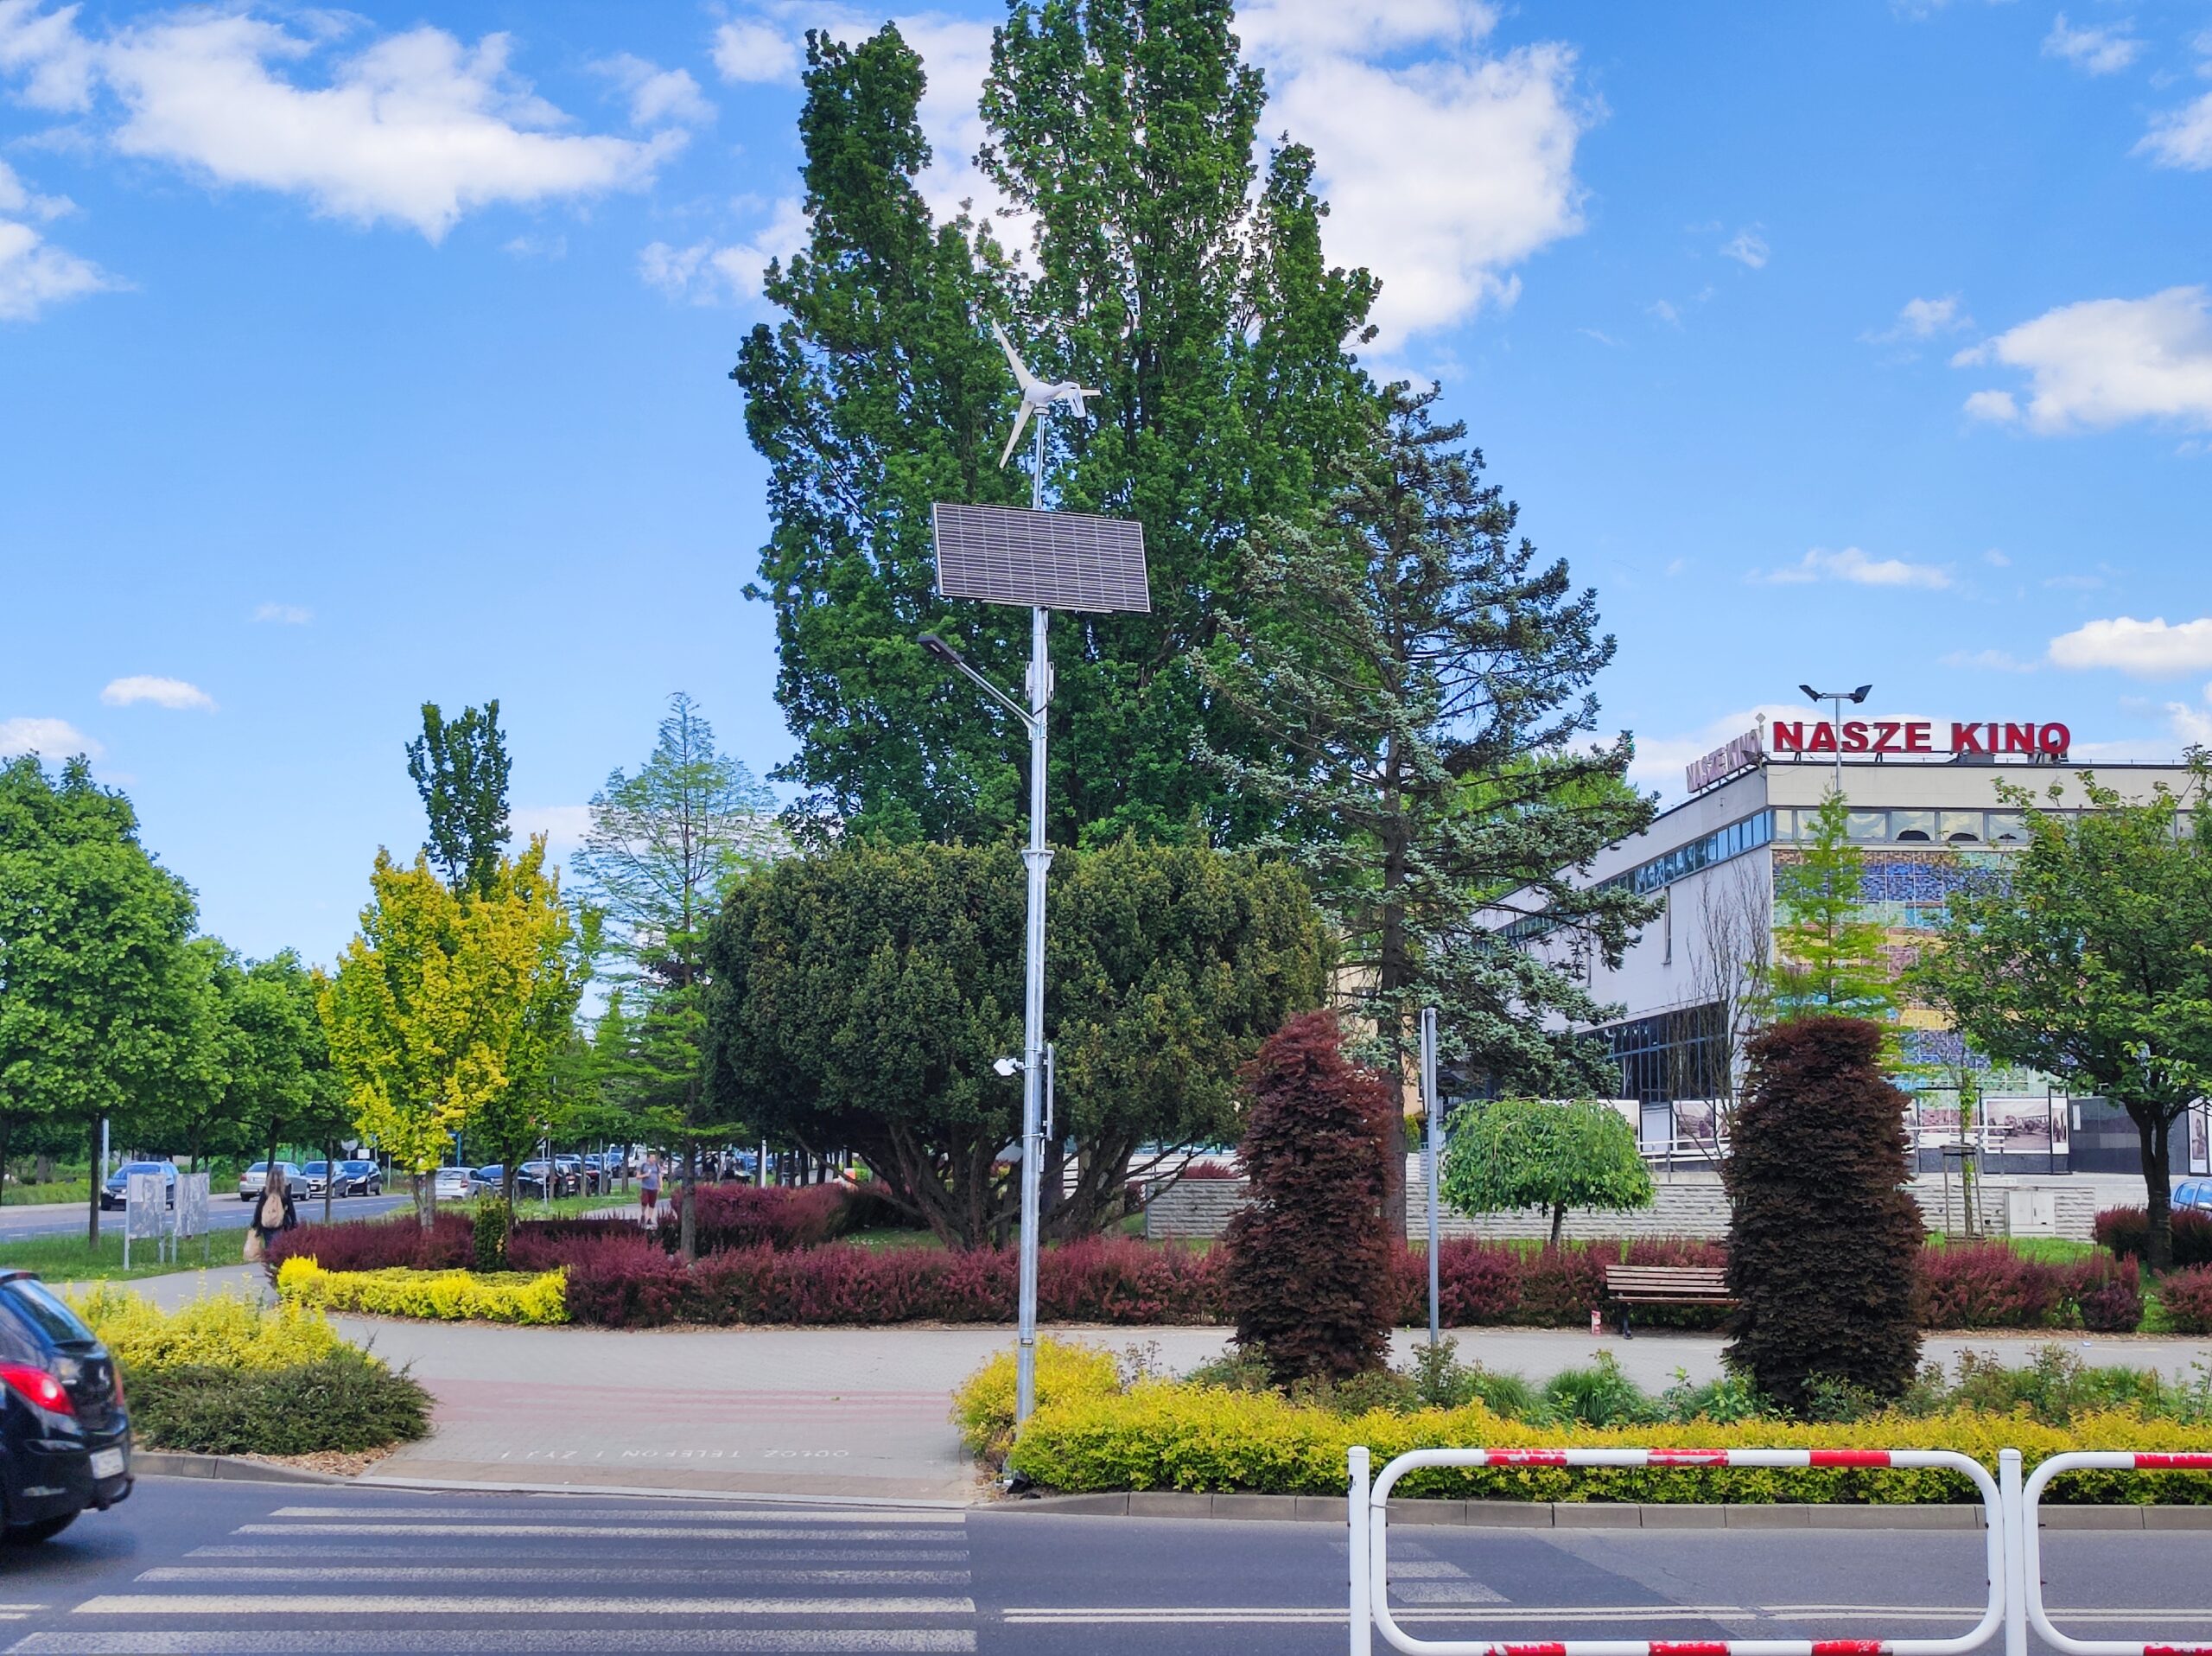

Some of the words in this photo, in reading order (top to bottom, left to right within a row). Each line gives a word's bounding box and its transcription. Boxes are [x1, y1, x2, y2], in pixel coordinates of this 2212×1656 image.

[1773, 721, 1932, 753] NASZE
[1951, 722, 2071, 755] KINO
[1686, 748, 1728, 793] NASZE
[621, 1449, 741, 1458] TELEFON
